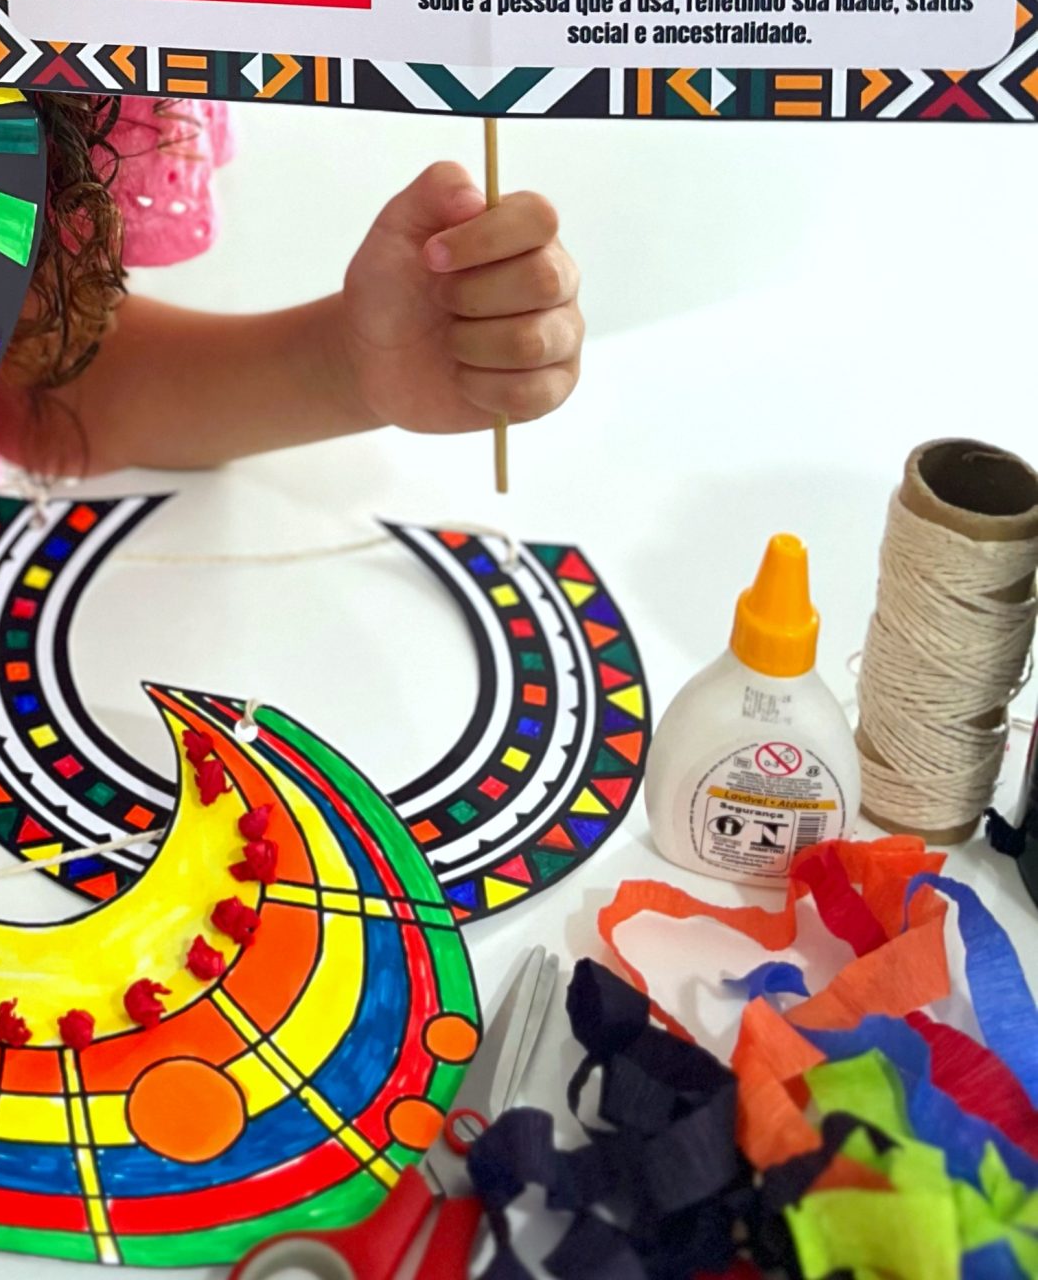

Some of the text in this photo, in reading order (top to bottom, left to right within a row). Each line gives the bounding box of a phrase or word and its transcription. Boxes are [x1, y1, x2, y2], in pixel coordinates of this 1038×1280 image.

[567, 21, 812, 44] social e ancestralidade.
[719, 801, 785, 819] Segurança
[777, 798, 819, 810] Atóxico
